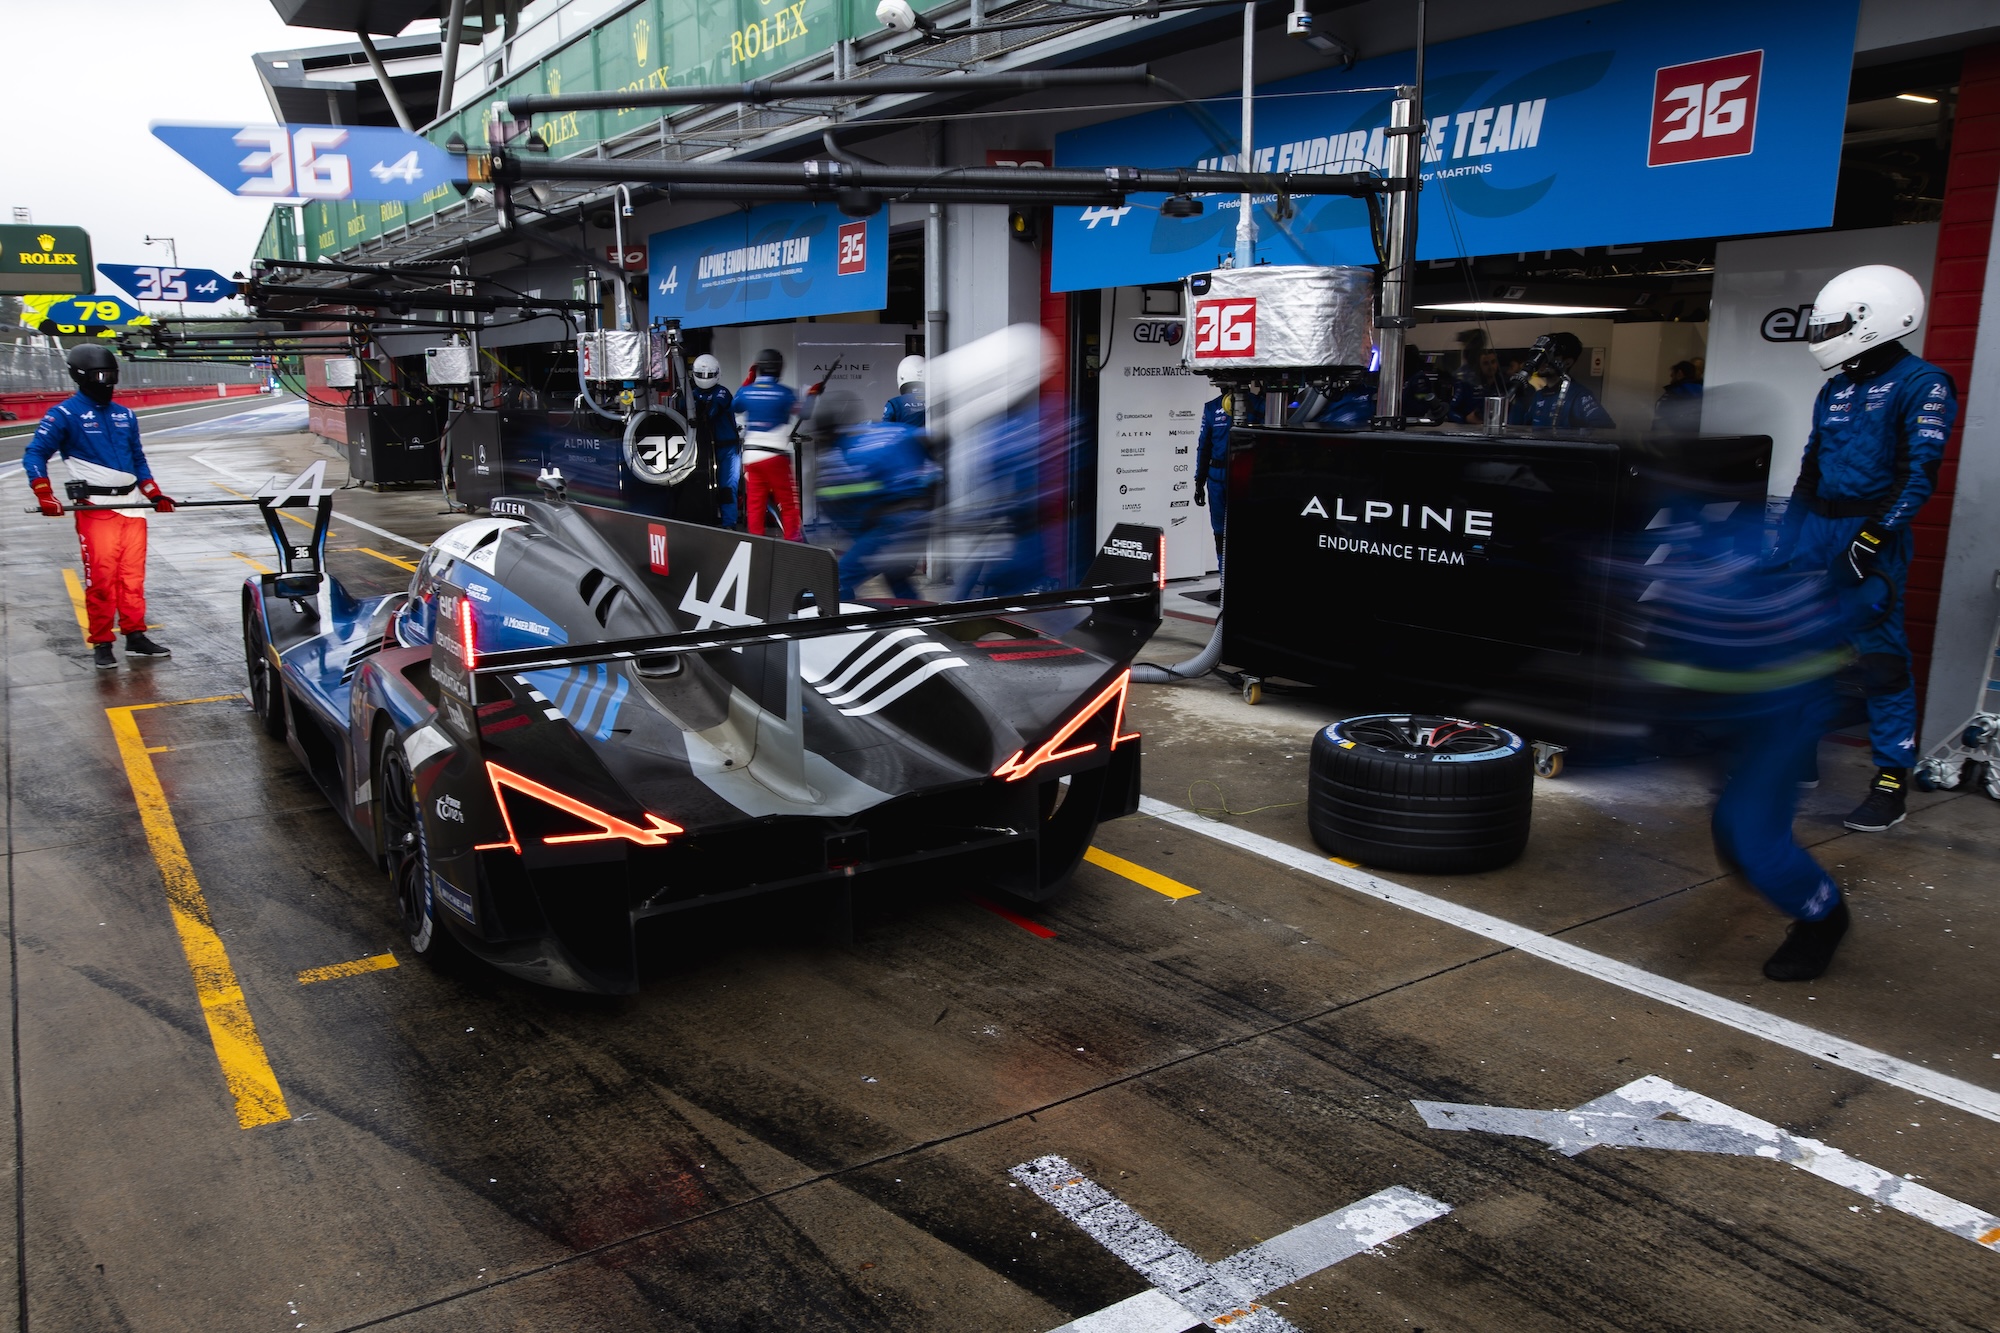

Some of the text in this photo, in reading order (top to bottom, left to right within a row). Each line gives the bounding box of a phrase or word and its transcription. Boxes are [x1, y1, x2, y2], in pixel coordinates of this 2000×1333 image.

[731, 3, 808, 66] ROLEX
[1657, 74, 1752, 145] 36
[1452, 97, 1547, 159] TEAM
[233, 126, 352, 198] 36
[1436, 164, 1493, 180] MARTINS
[19, 252, 79, 266] ROLEX
[698, 236, 810, 280] ALPINE ENDURANCE TEAM
[840, 232, 864, 264] 35
[133, 266, 189, 300] 35
[73, 301, 121, 321] 79
[1134, 323, 1167, 342] elf
[1196, 304, 1254, 351] 36
[564, 438, 600, 450] ALPINE
[1173, 464, 1189, 473] GCR
[494, 502, 526, 516] ALTEN
[1300, 495, 1494, 537] ALPINE
[294, 546, 310, 558] 36
[649, 533, 667, 566] HY
[1103, 545, 1154, 561] TECHNOLOGY
[1111, 538, 1143, 551] CHEOPS
[1318, 534, 1465, 566] ENDURANCE TEAM
[439, 595, 453, 620] elf
[508, 616, 550, 637] MOSER.WATCH
